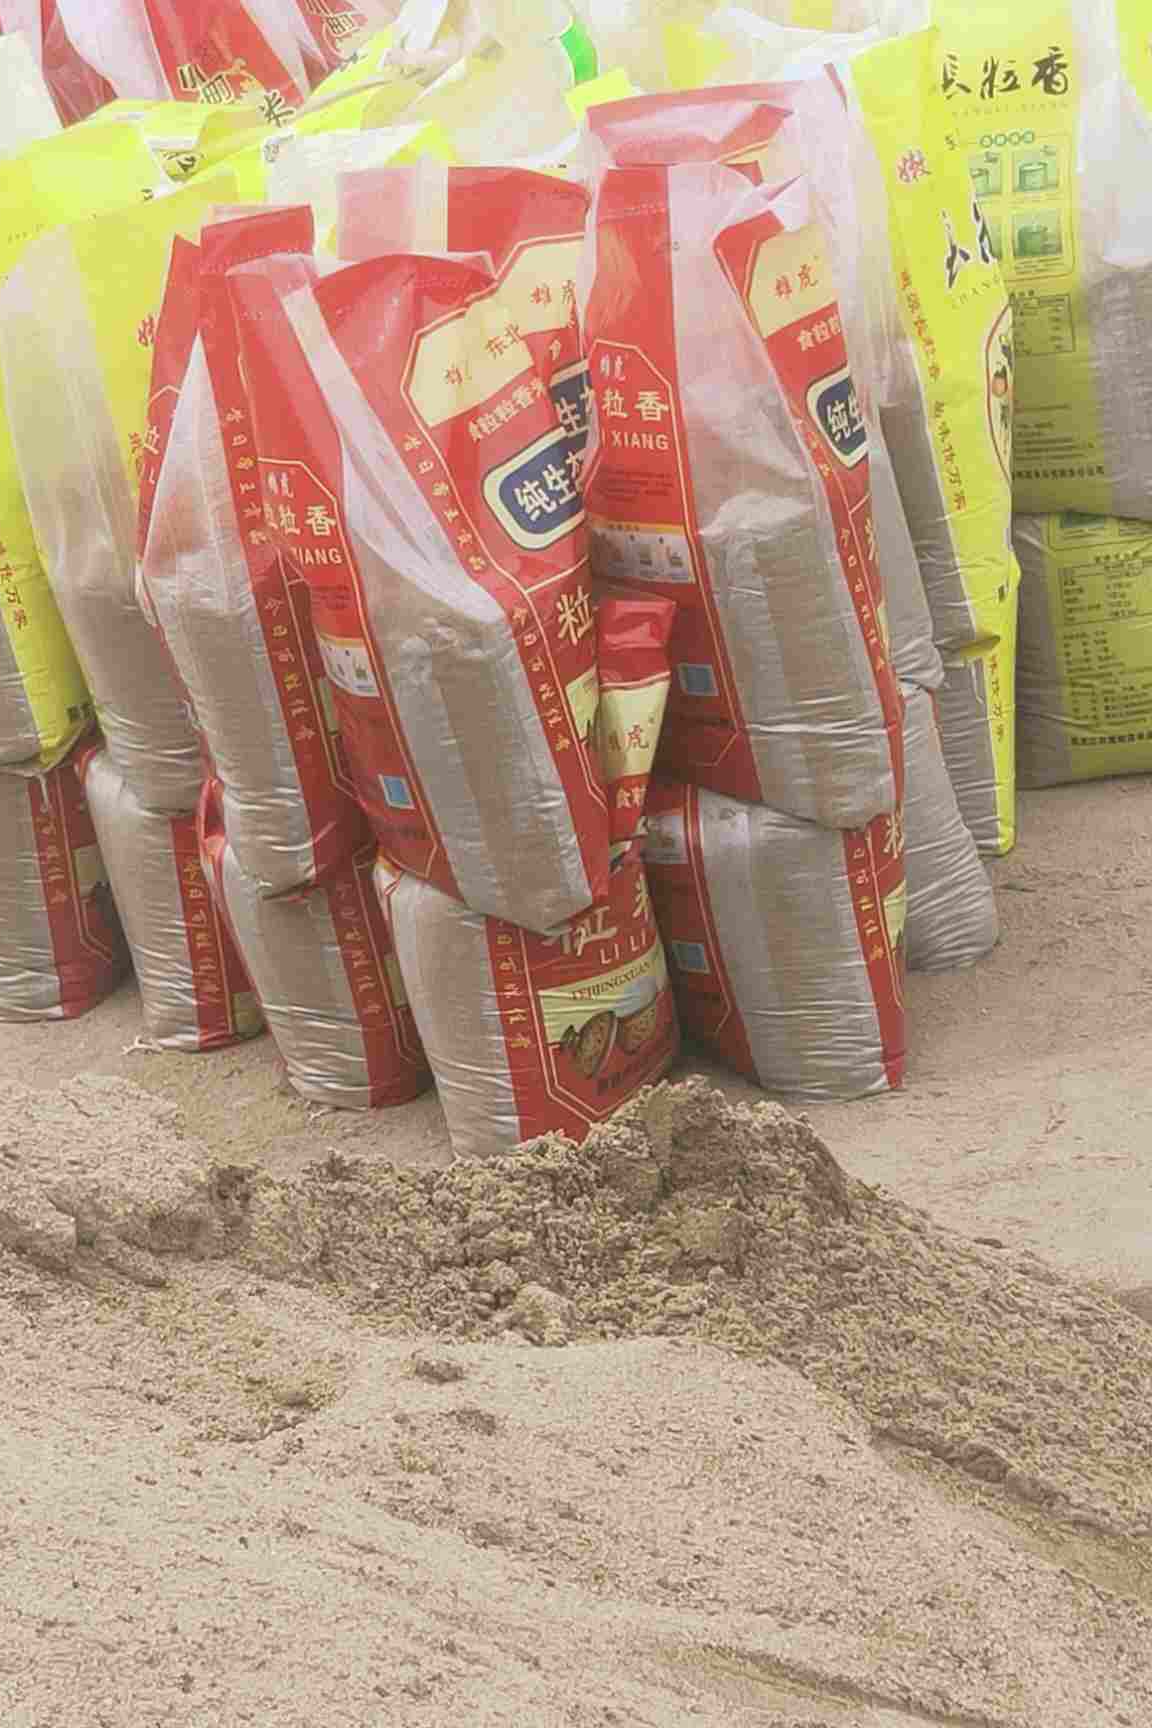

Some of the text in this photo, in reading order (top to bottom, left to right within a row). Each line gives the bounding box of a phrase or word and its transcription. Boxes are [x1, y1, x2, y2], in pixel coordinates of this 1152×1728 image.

[611, 430, 670, 450] XIANG
[600, 928, 648, 965] LI LI
